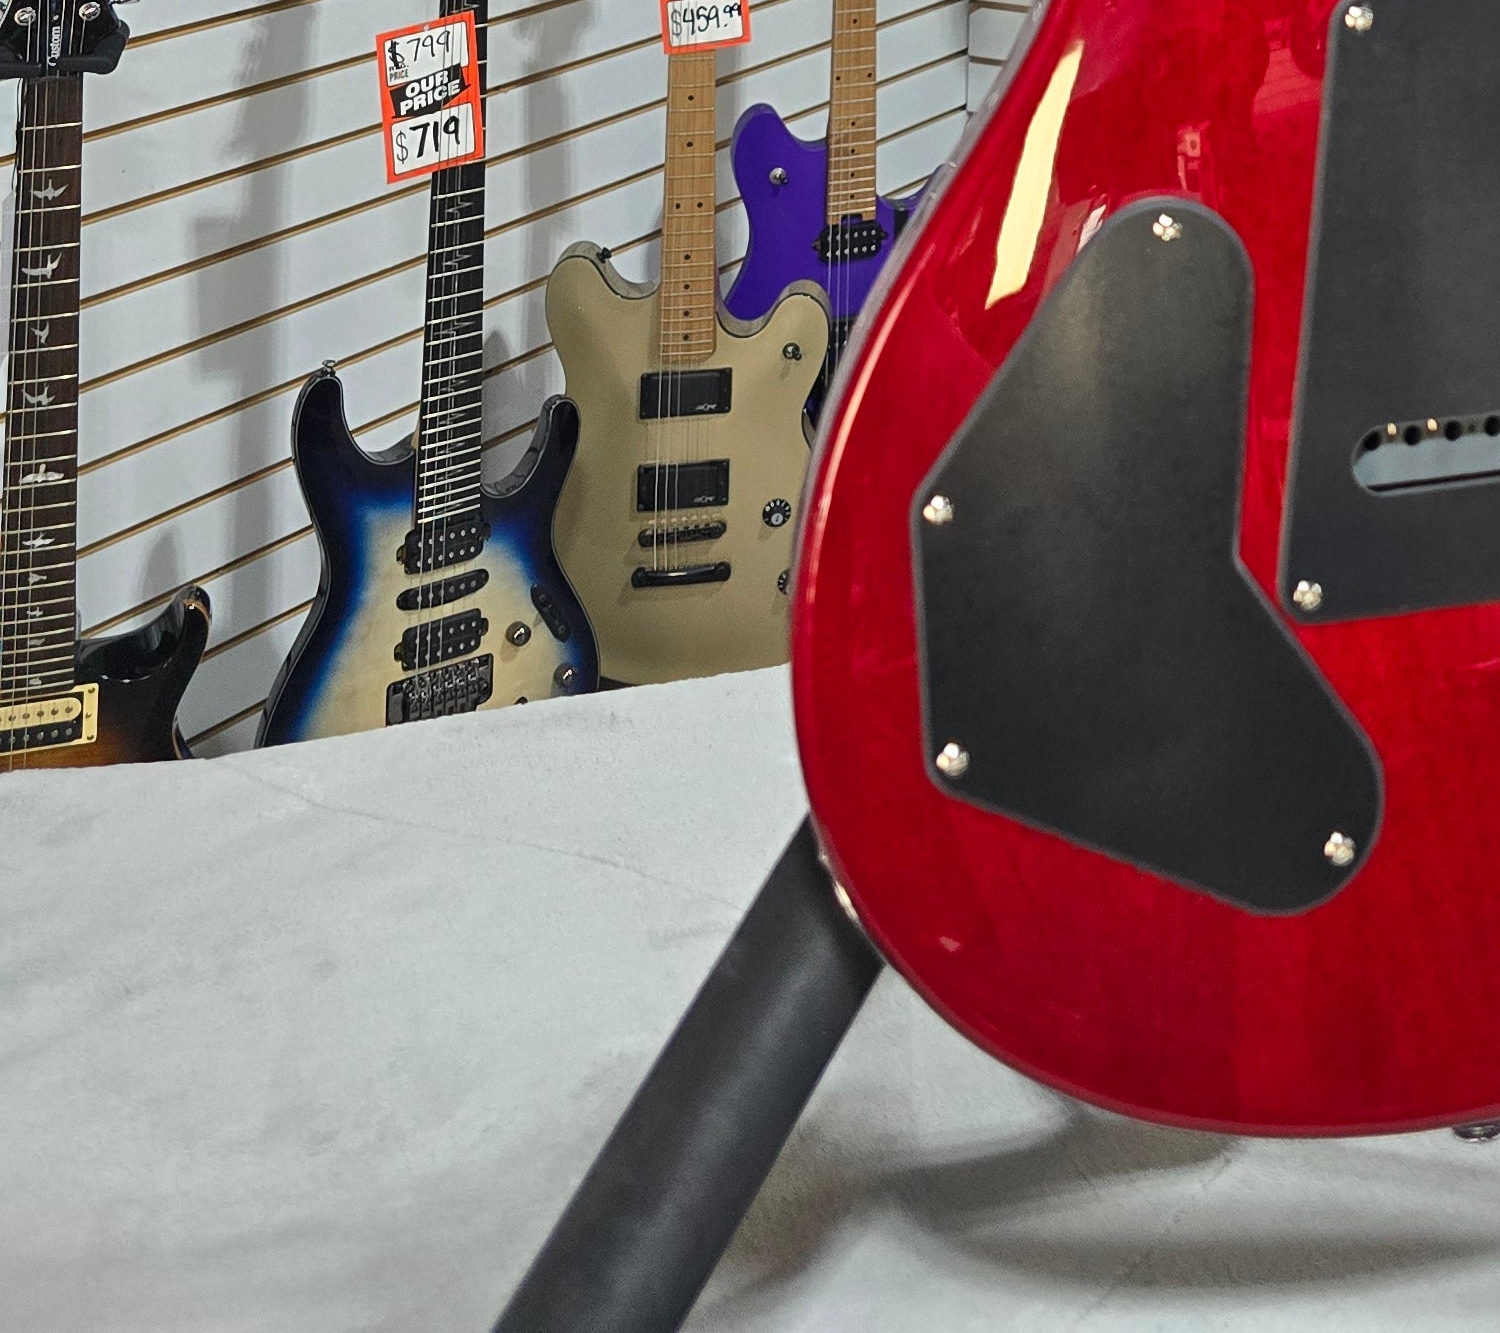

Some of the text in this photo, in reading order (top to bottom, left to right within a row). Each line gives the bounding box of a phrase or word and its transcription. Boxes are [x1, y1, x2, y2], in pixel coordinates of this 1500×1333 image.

[671, 2, 742, 38] $459.99
[48, 25, 62, 67] Custom
[388, 30, 451, 70] $799
[389, 70, 409, 82] PRICE
[405, 70, 449, 98] OUR
[400, 79, 461, 117] PRICE
[396, 115, 460, 164] $719
